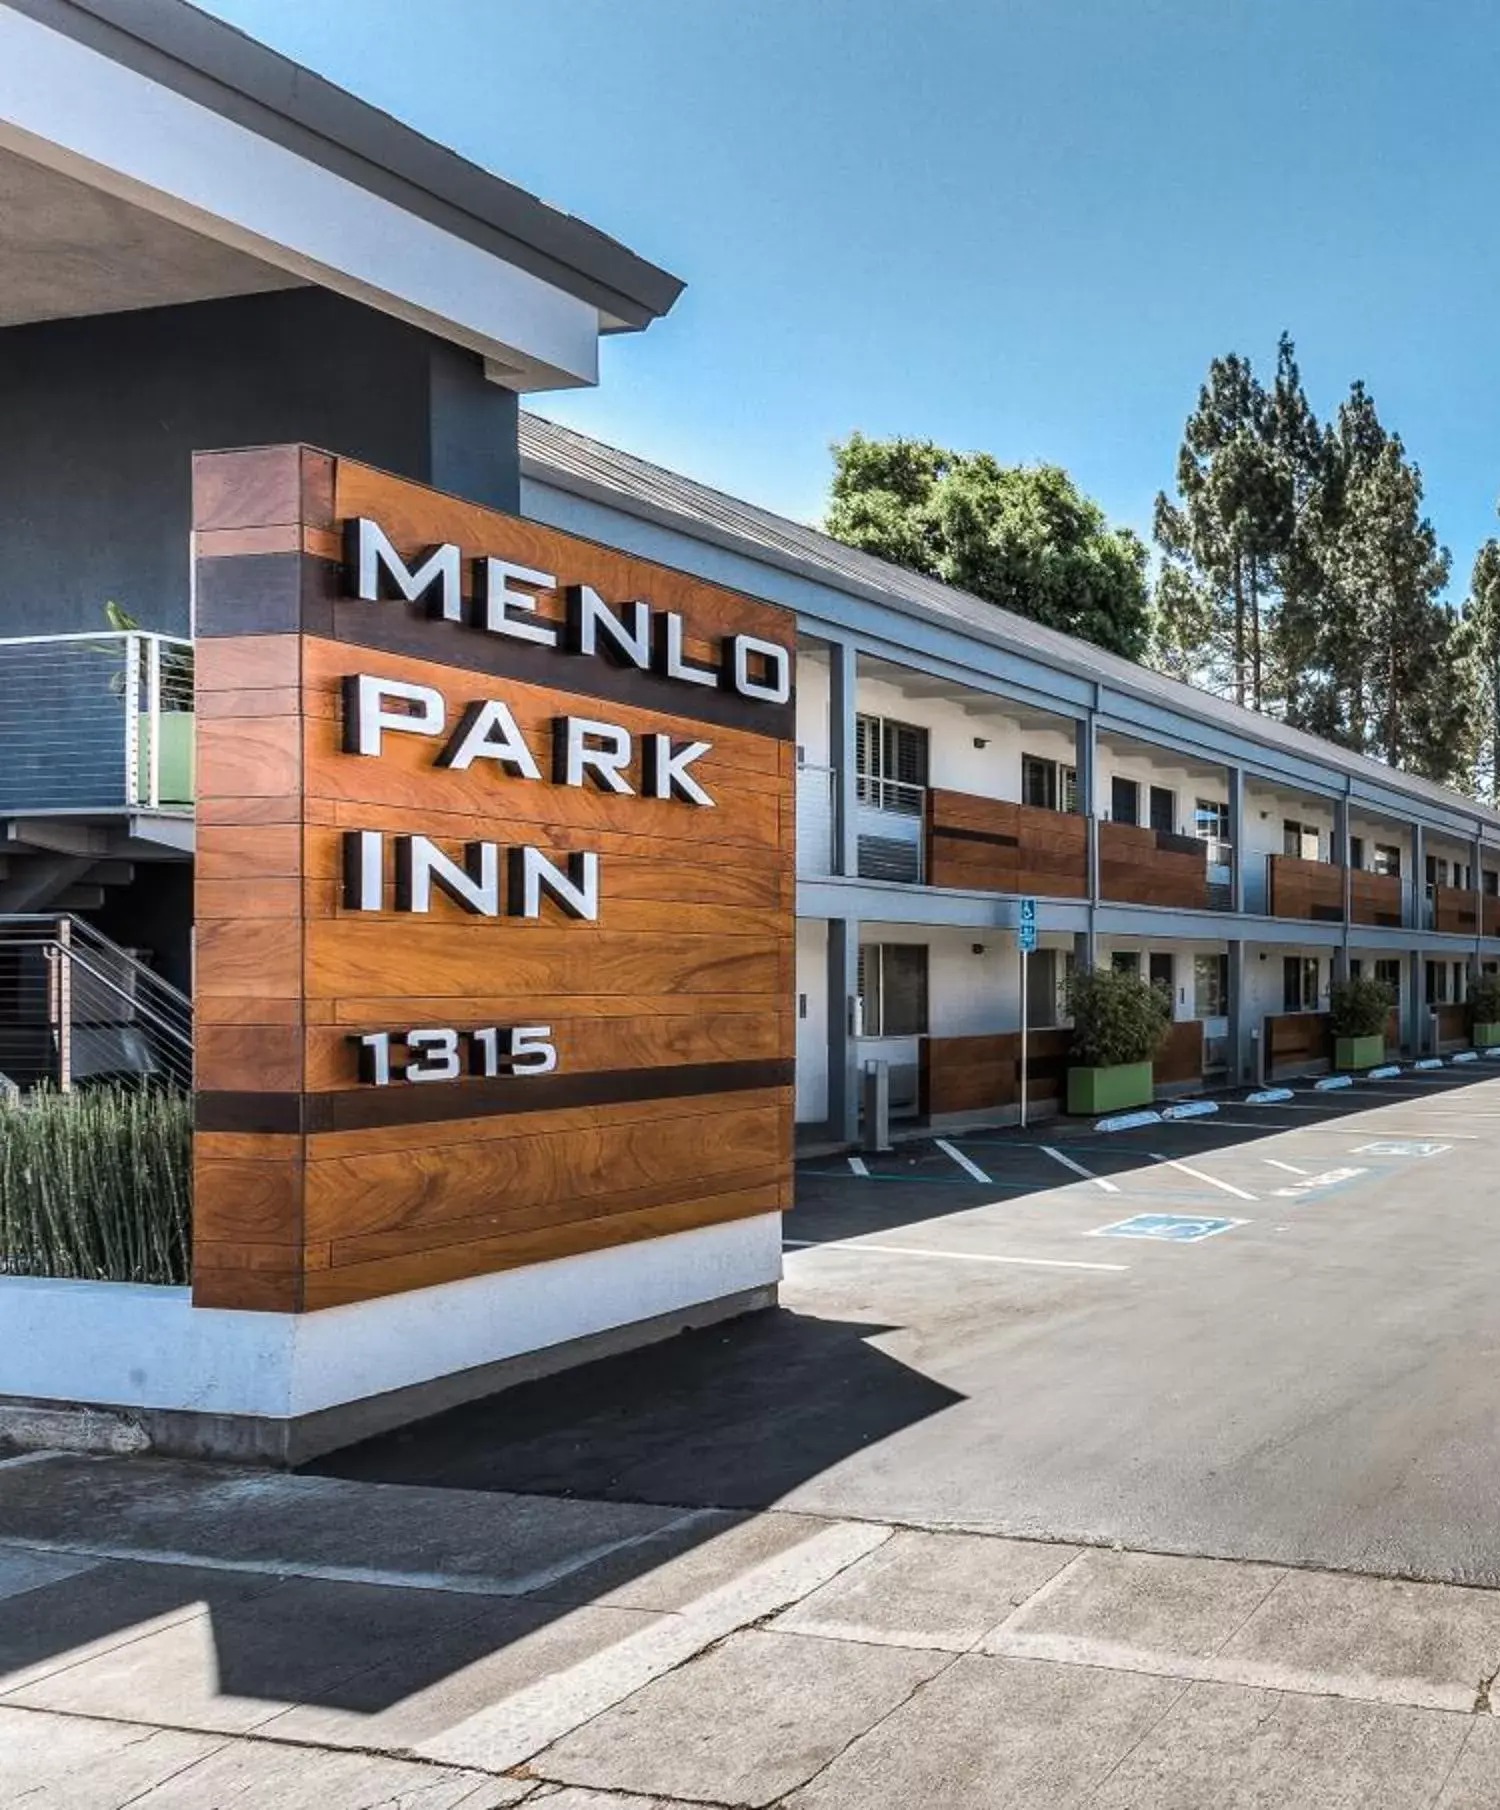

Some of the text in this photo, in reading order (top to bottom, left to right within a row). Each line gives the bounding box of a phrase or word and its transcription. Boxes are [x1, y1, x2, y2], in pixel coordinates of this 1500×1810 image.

[357, 516, 790, 705] MENLO
[357, 673, 716, 807] PARK
[359, 830, 598, 921] INN
[361, 1025, 559, 1086] 1315
